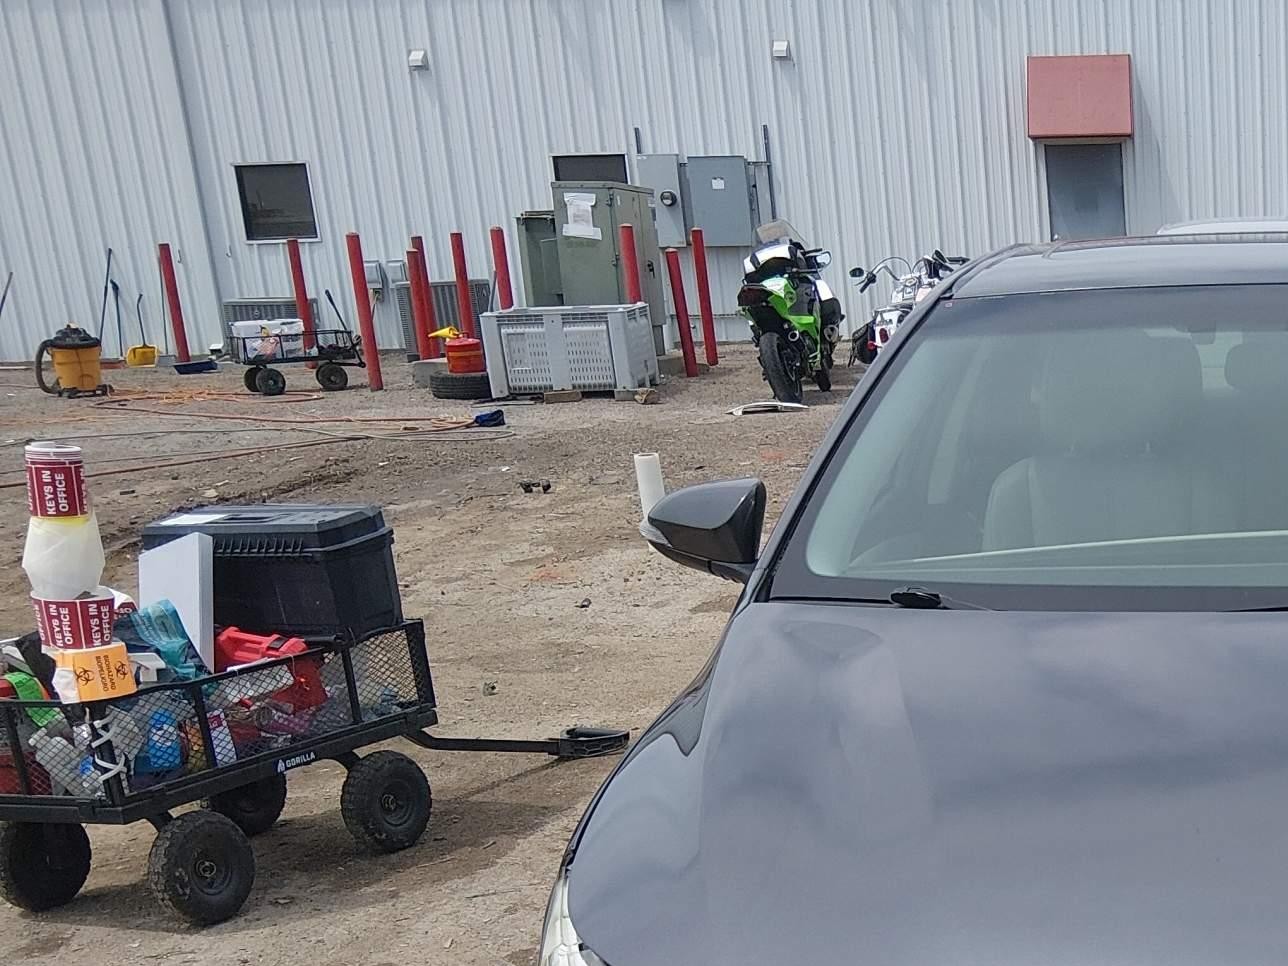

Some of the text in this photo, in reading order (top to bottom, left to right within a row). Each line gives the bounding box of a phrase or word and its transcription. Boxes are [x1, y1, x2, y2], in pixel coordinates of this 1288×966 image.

[41, 470, 57, 514] KEYS IN
[54, 473, 69, 512] OFFICE
[49, 604, 64, 647] KEYS IN
[60, 607, 73, 645] OFFICE
[88, 603, 102, 647] KEYS IN
[101, 605, 111, 642] OFFICE
[103, 654, 116, 690] BIOHAZARD
[285, 751, 316, 768] GORILLA
